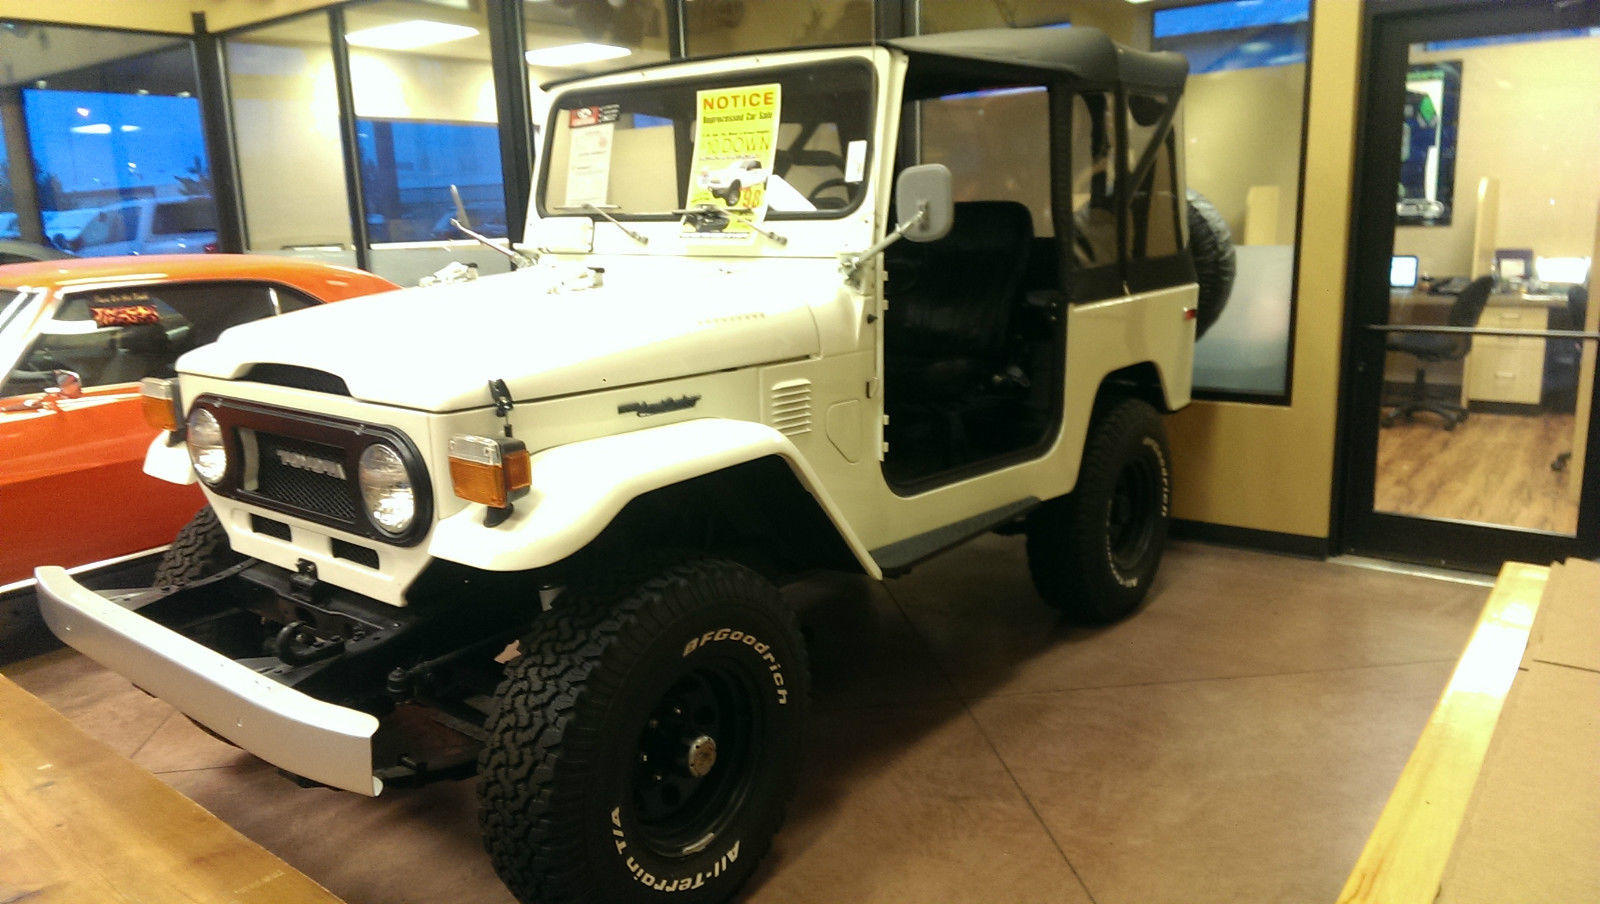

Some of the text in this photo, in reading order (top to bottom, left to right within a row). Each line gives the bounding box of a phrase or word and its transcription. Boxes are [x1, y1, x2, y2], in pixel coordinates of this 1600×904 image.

[703, 91, 774, 110] NOTICE
[721, 135, 770, 153] DOWN
[682, 627, 788, 706] BFGoodrich
[610, 806, 628, 856] T/A
